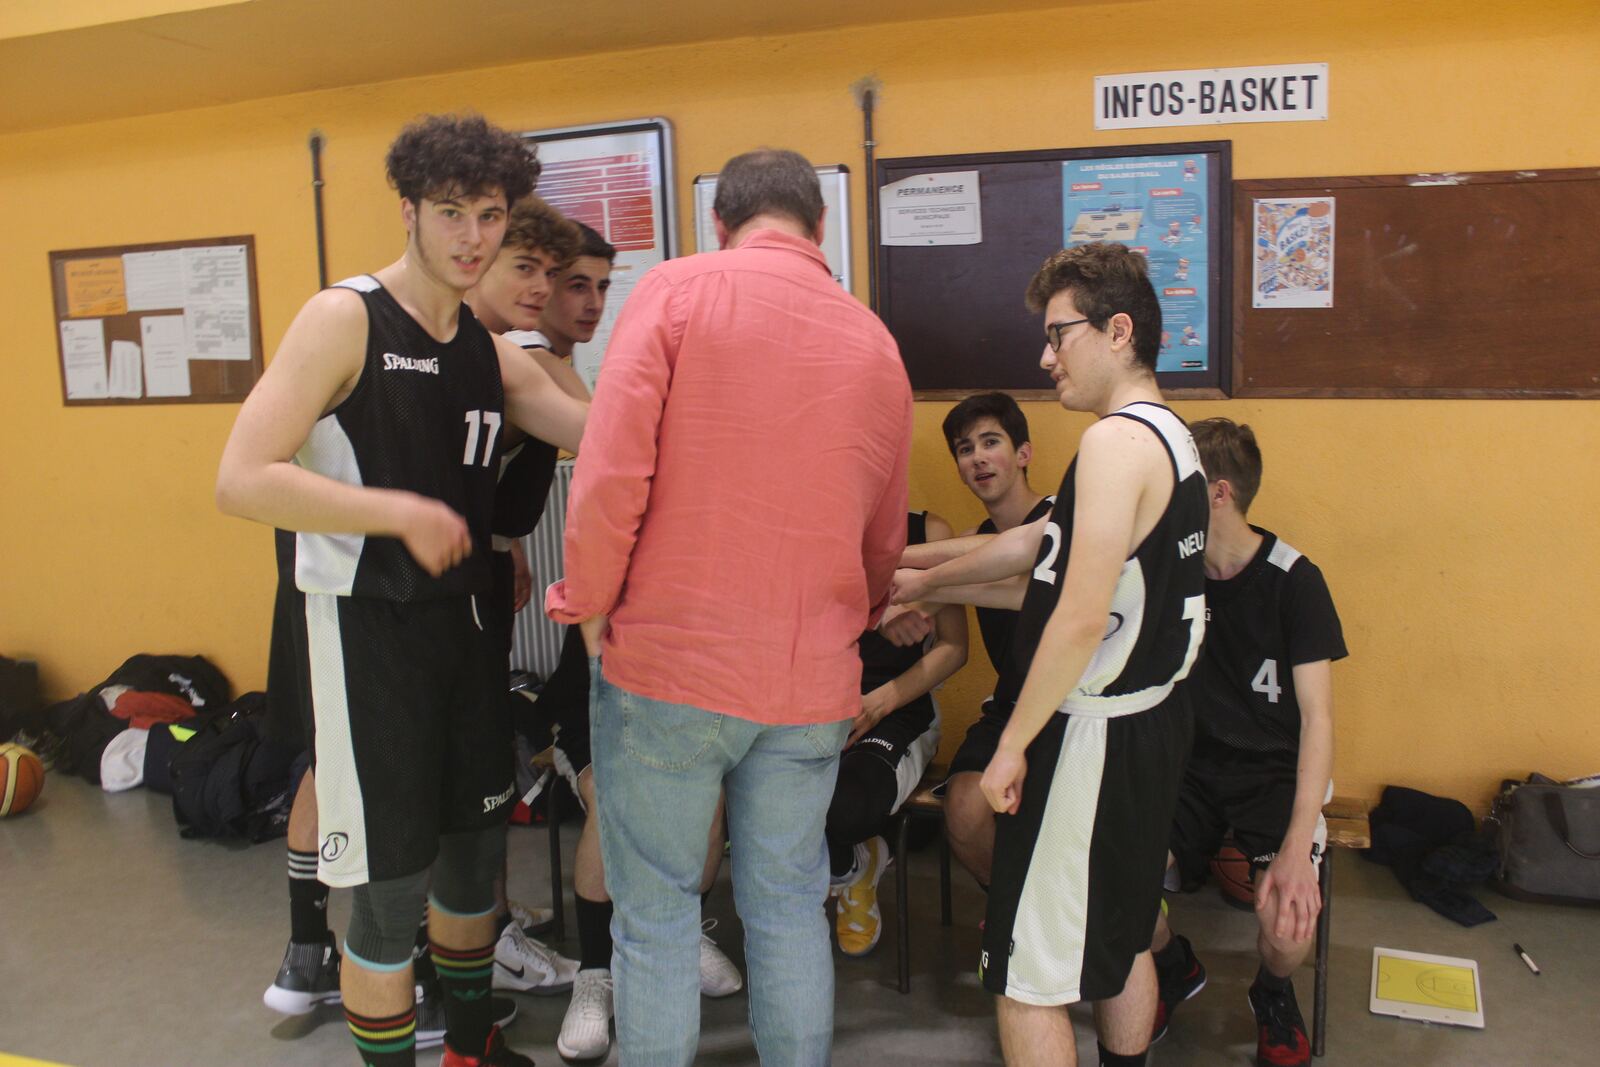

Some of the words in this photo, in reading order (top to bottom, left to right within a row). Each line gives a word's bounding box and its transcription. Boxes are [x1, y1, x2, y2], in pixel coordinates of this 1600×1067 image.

[1103, 75, 1319, 119] INFOS-BASKET
[897, 184, 964, 196] PERMANENCE
[463, 409, 501, 467] 17
[1251, 658, 1282, 703] 4
